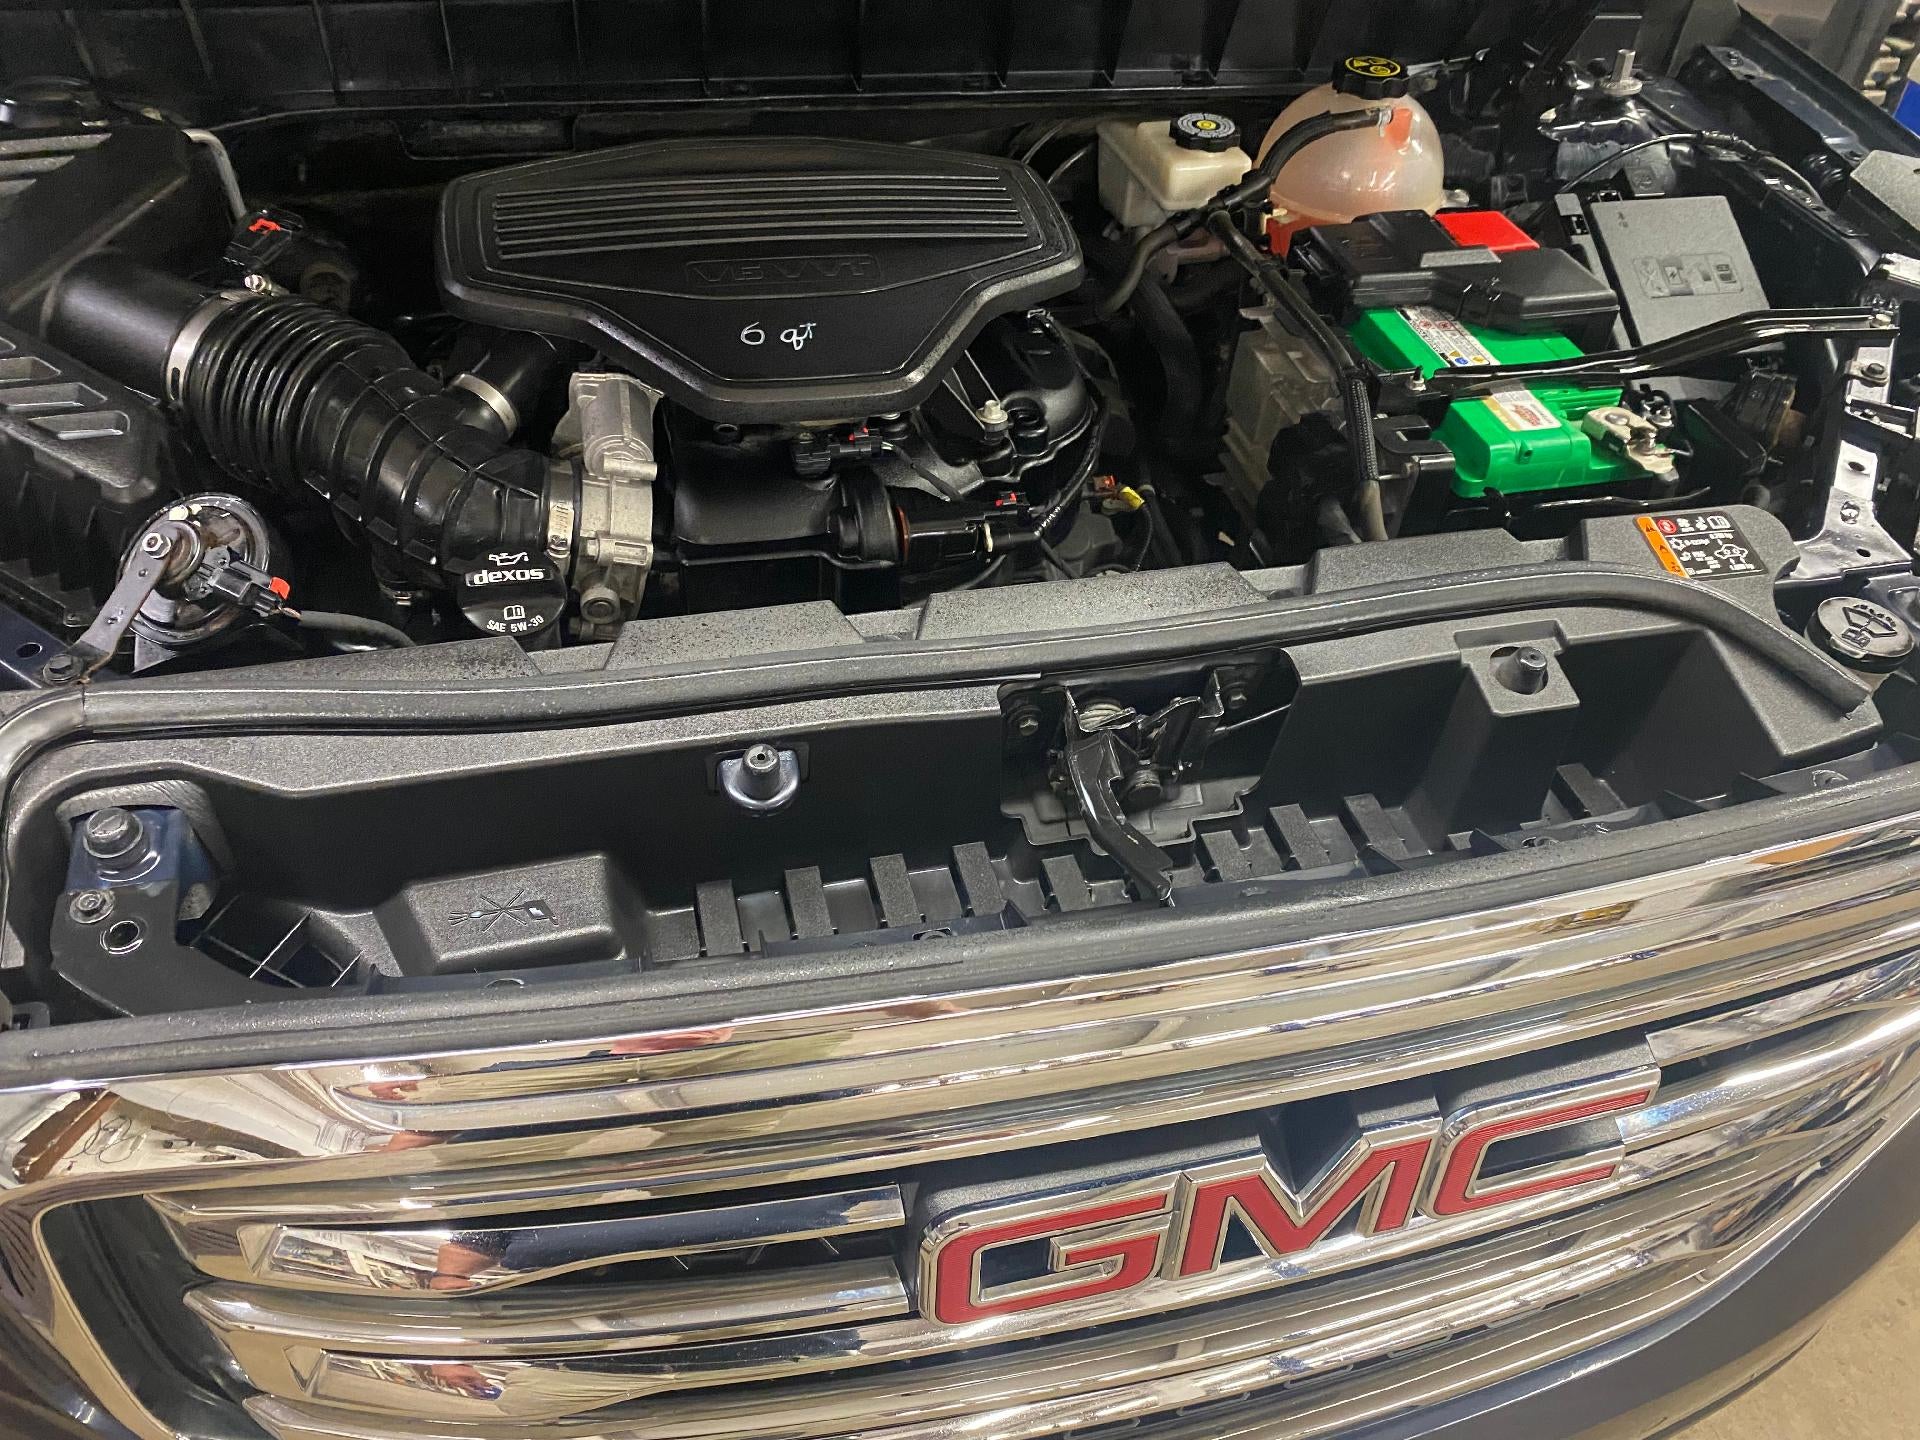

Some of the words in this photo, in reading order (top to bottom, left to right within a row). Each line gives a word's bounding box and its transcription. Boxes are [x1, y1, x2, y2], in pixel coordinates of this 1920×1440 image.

[740, 322, 765, 346] 6
[473, 568, 545, 585] dexos
[486, 619, 507, 632] SAE
[510, 615, 545, 633] 5W-30
[919, 1064, 1660, 1325] GMC
